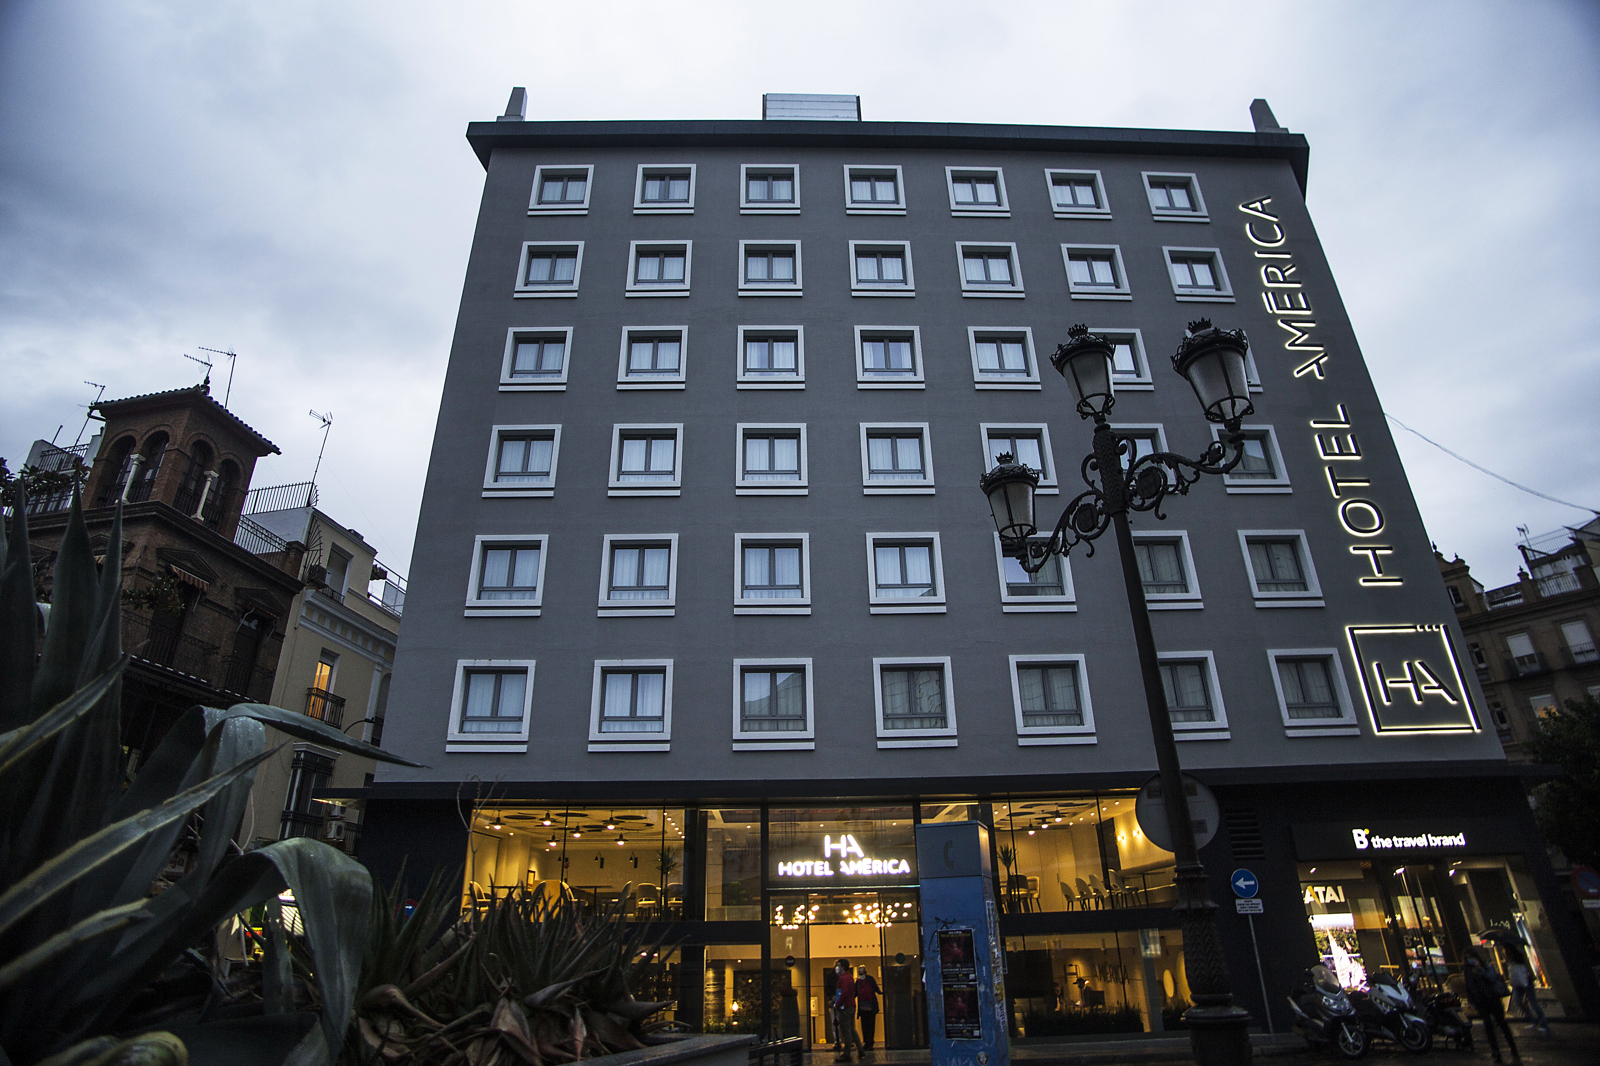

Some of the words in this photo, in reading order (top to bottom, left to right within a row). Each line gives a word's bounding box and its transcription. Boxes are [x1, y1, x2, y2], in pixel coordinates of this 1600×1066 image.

[1239, 195, 1329, 380] AMÉRICA
[1309, 403, 1404, 587] HOTEL
[1373, 660, 1459, 706] HA
[824, 834, 865, 858] HA
[1371, 835, 1393, 849] the
[1392, 833, 1429, 848] travel
[1427, 832, 1467, 847] brand
[778, 860, 835, 877] HOTEL
[1302, 885, 1346, 905] ATAI
